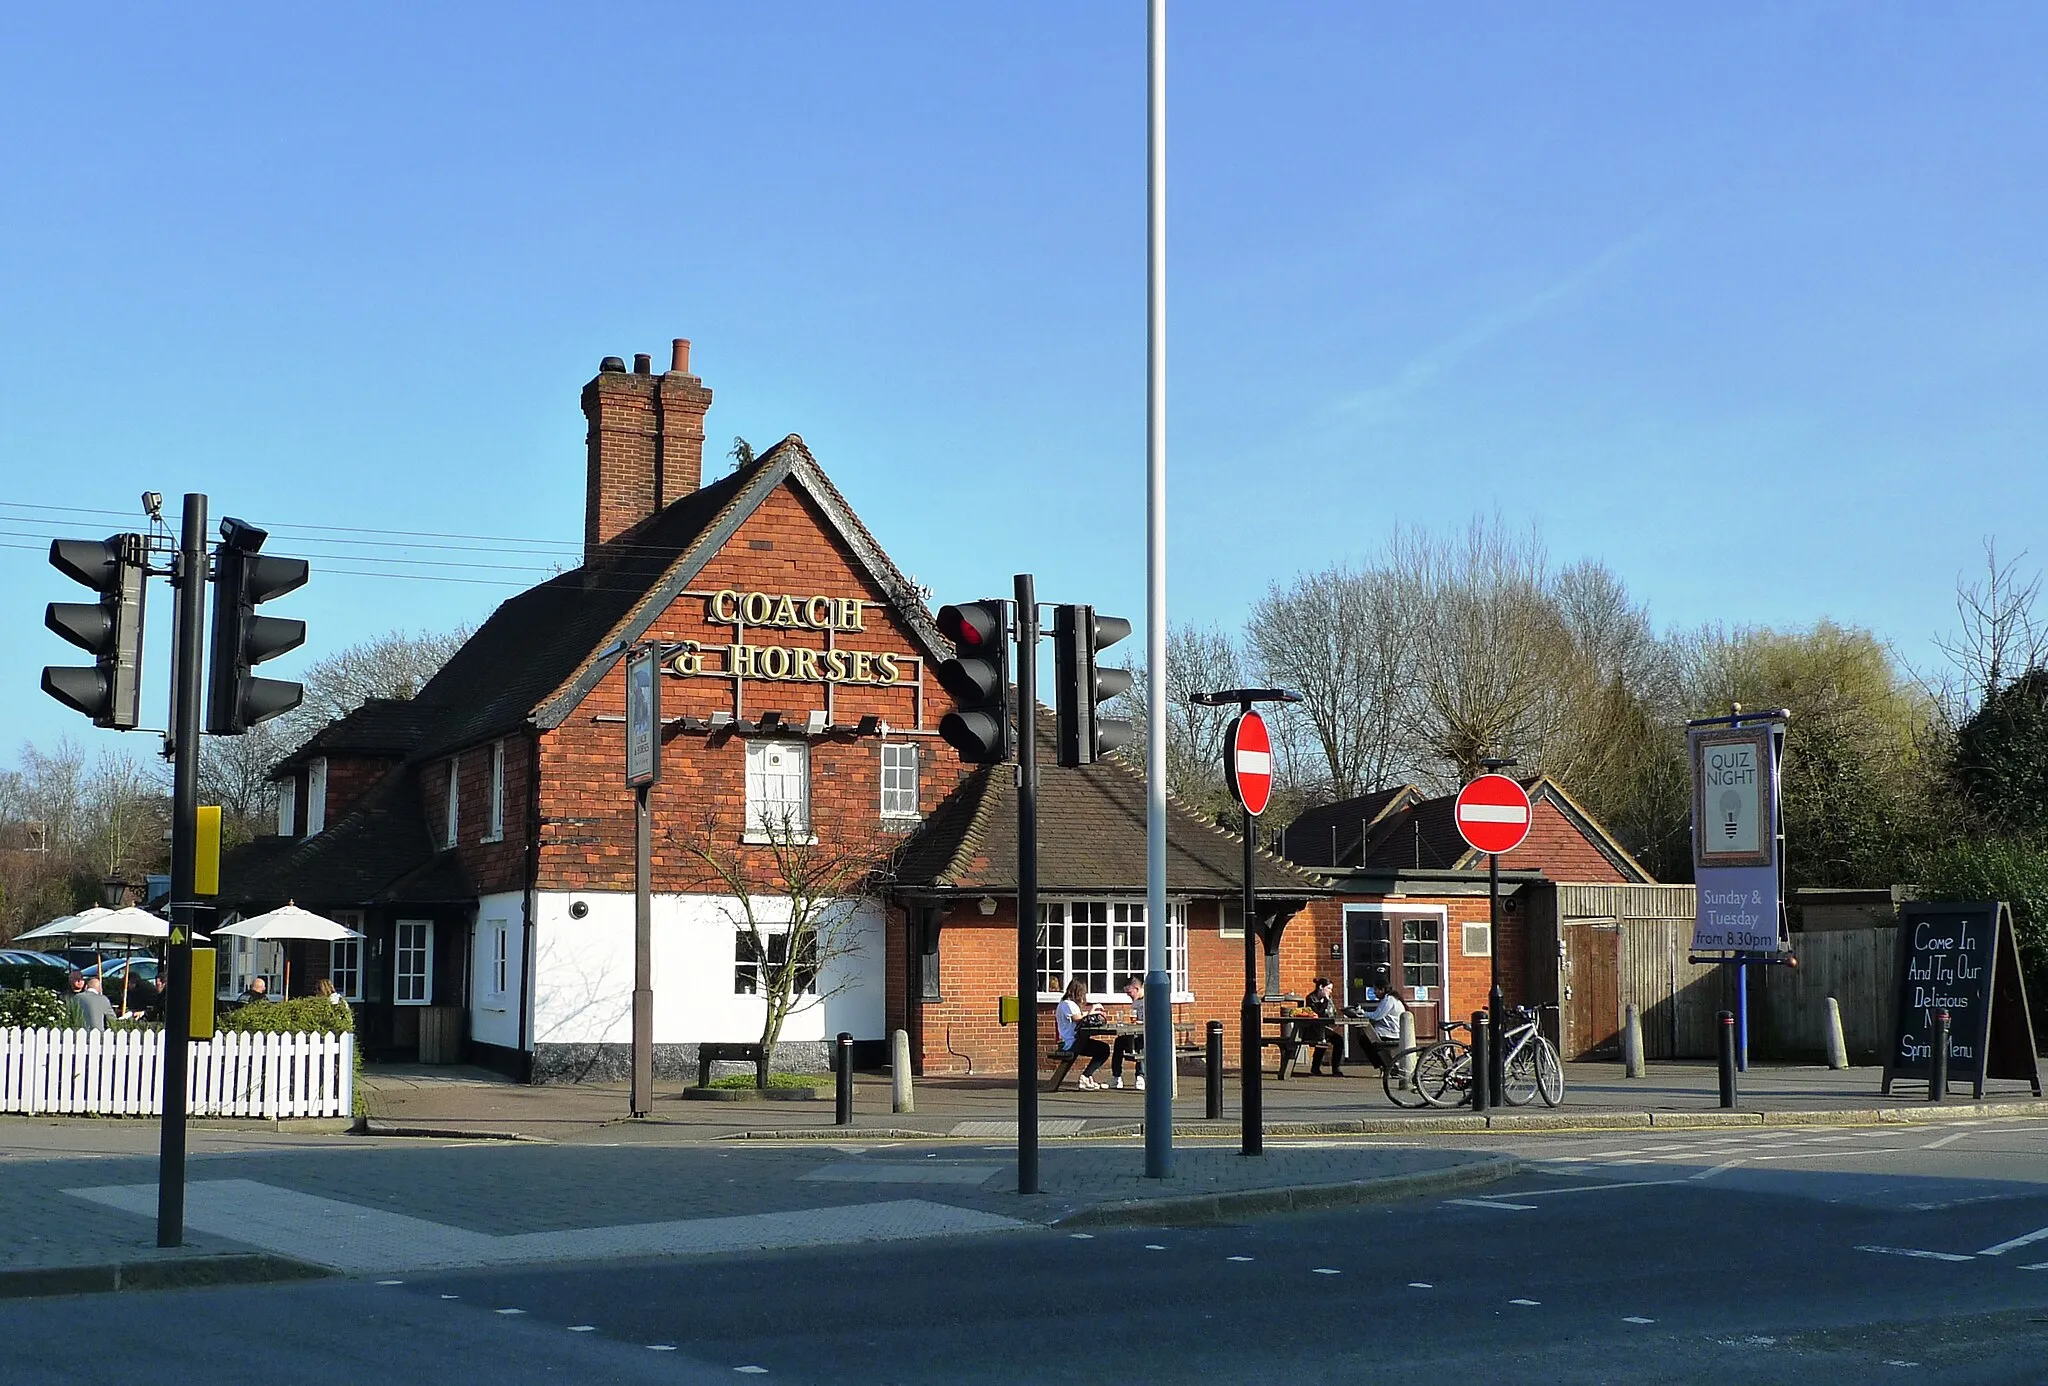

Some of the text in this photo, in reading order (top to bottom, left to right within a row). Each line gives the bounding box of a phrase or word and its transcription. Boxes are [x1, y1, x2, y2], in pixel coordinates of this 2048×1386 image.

[711, 589, 866, 631] COACH
[672, 639, 900, 684] & HORSES
[1711, 752, 1750, 771] QUIZ
[1707, 769, 1755, 786] NIGHT
[1704, 889, 1762, 909] Sunday &
[1707, 910, 1759, 930] Tuesday
[1696, 931, 1772, 949] from 8.30pm
[1958, 920, 1976, 951] In
[1908, 954, 1981, 985] And Try Our
[1914, 986, 1969, 1008] Delicious
[1901, 1034, 1932, 1061] Sprin
